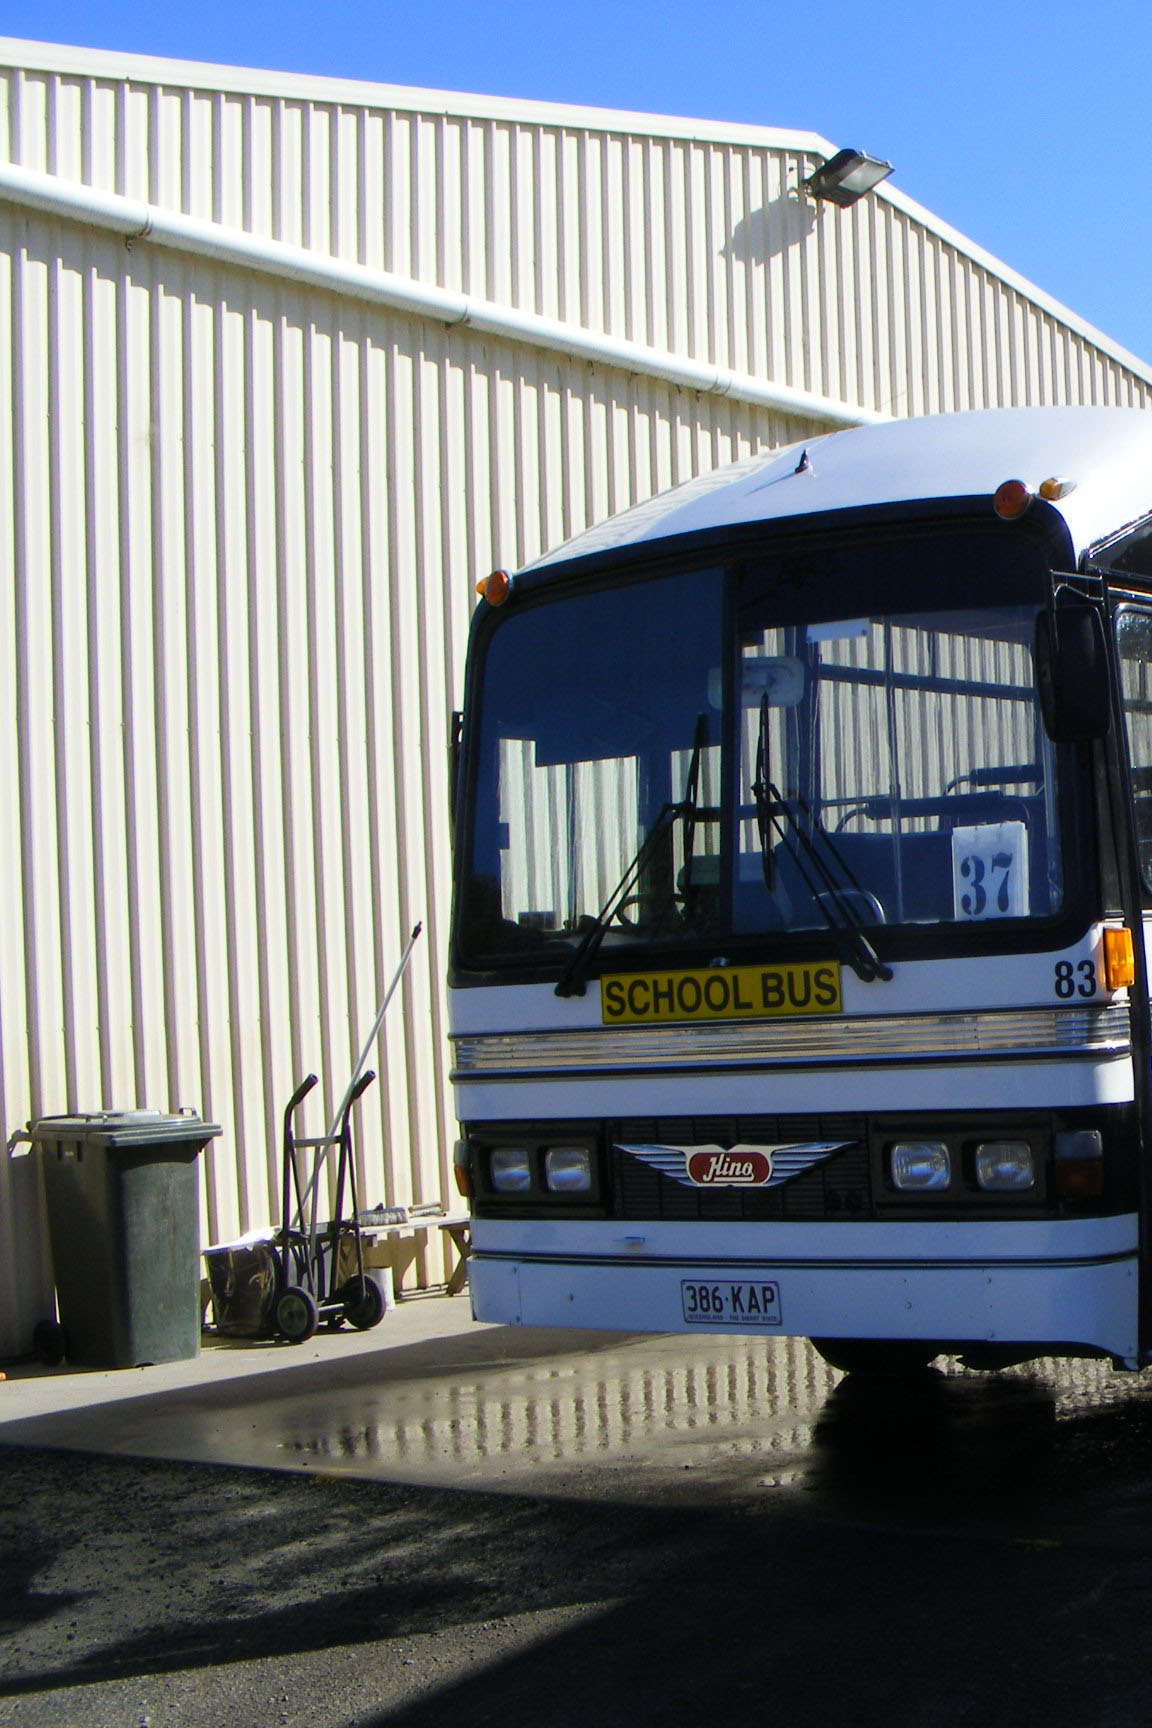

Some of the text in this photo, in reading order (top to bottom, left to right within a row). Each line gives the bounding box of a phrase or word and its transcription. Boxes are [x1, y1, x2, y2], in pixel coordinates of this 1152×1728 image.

[961, 852, 1013, 916] 37
[605, 968, 838, 1017] SCHOOL BUS
[1055, 960, 1096, 998] 83
[703, 1153, 755, 1182] Hino
